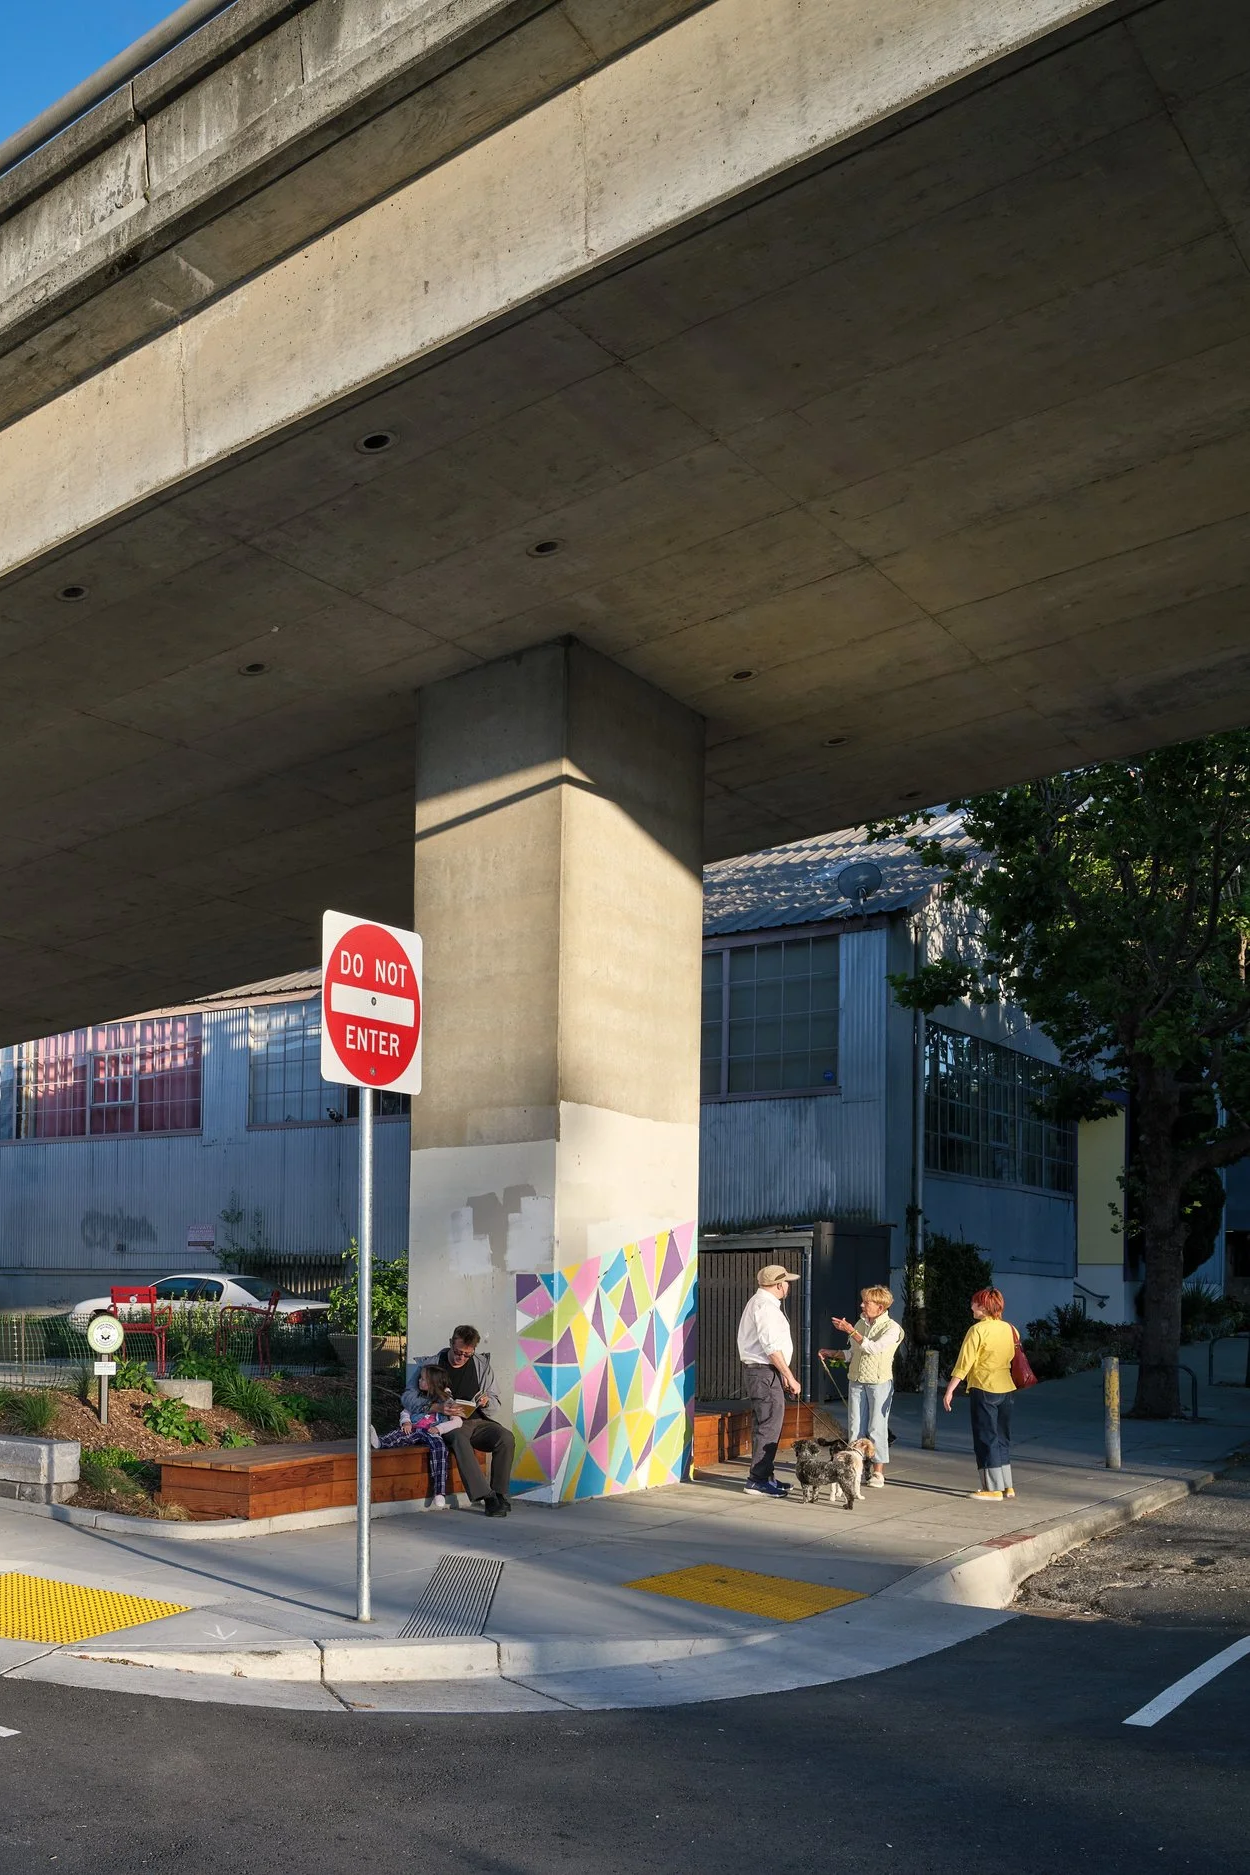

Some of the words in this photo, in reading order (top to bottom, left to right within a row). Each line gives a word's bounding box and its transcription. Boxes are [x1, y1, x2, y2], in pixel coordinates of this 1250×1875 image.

[340, 950, 364, 978] DO
[375, 958, 407, 988] NOT
[345, 1024, 400, 1058] ENTER
